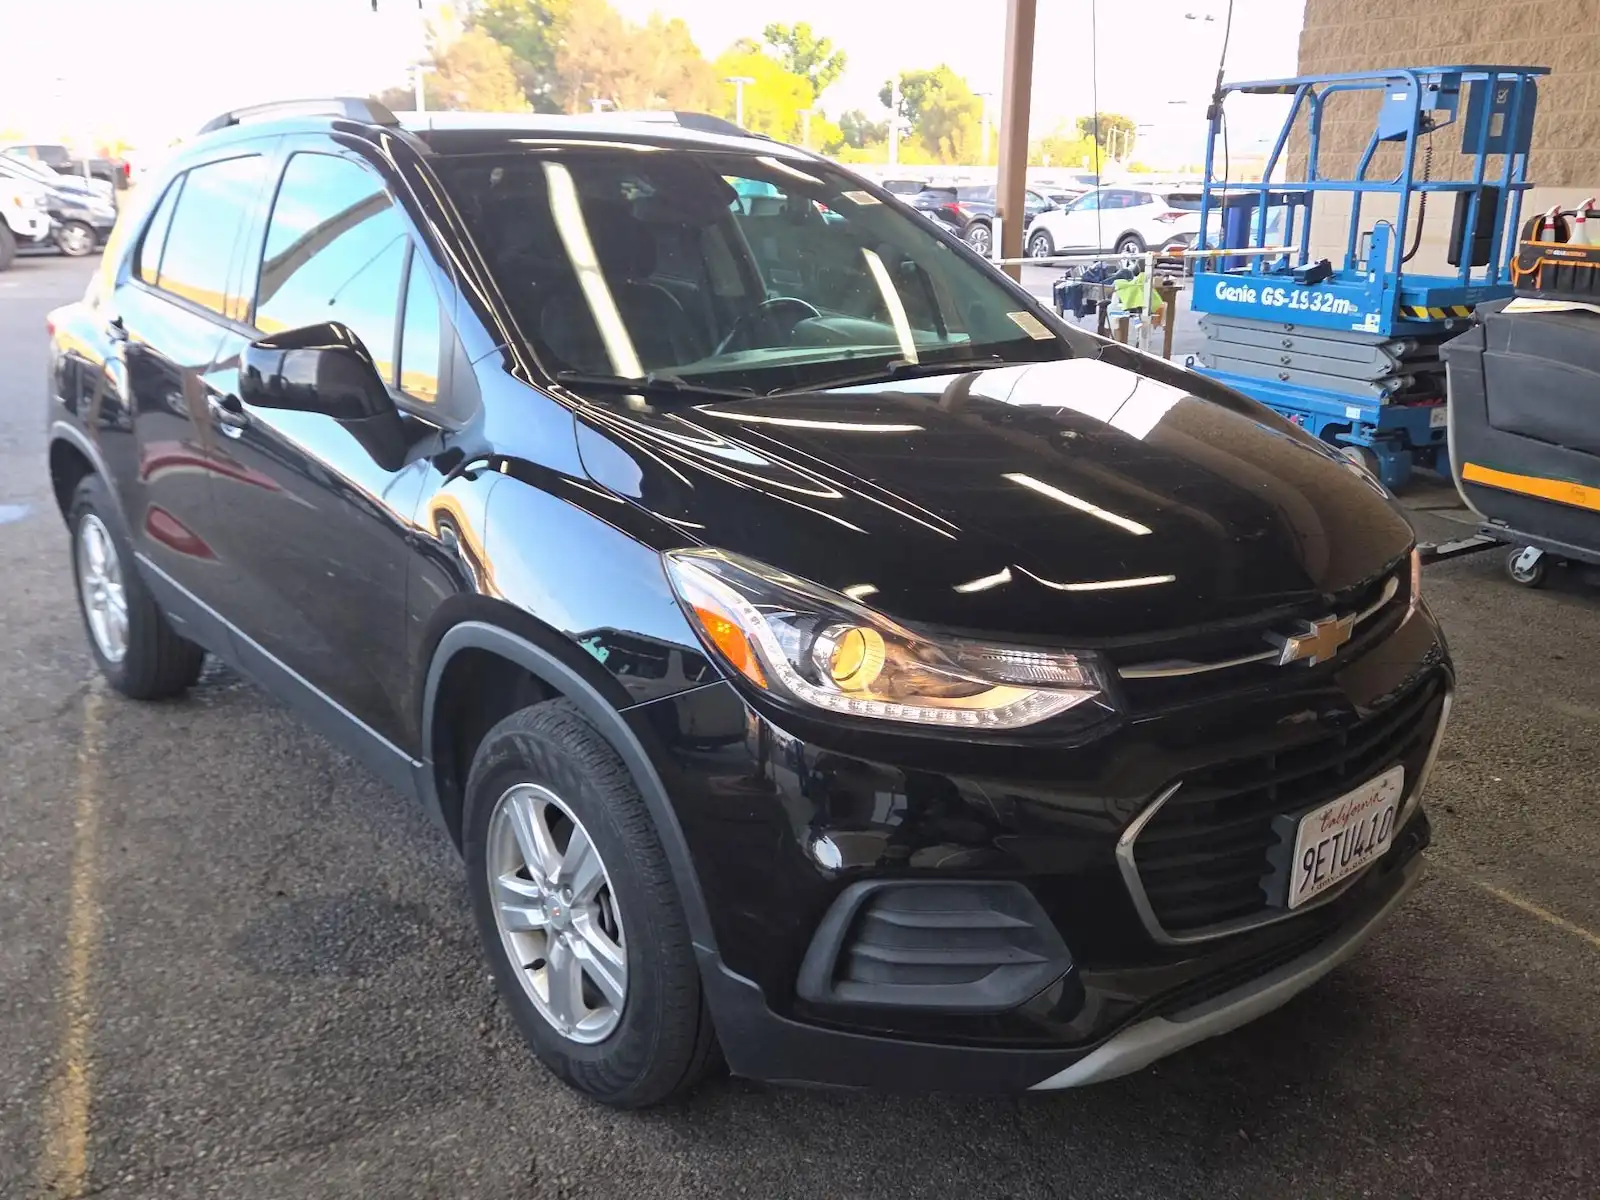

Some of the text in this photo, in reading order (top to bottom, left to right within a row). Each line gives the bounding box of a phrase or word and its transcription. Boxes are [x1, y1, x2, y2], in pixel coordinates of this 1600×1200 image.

[1215, 281, 1257, 303] Genie
[1261, 286, 1350, 315] GS-1932m
[1320, 792, 1386, 833] California
[1299, 805, 1394, 894] 9ETU410
